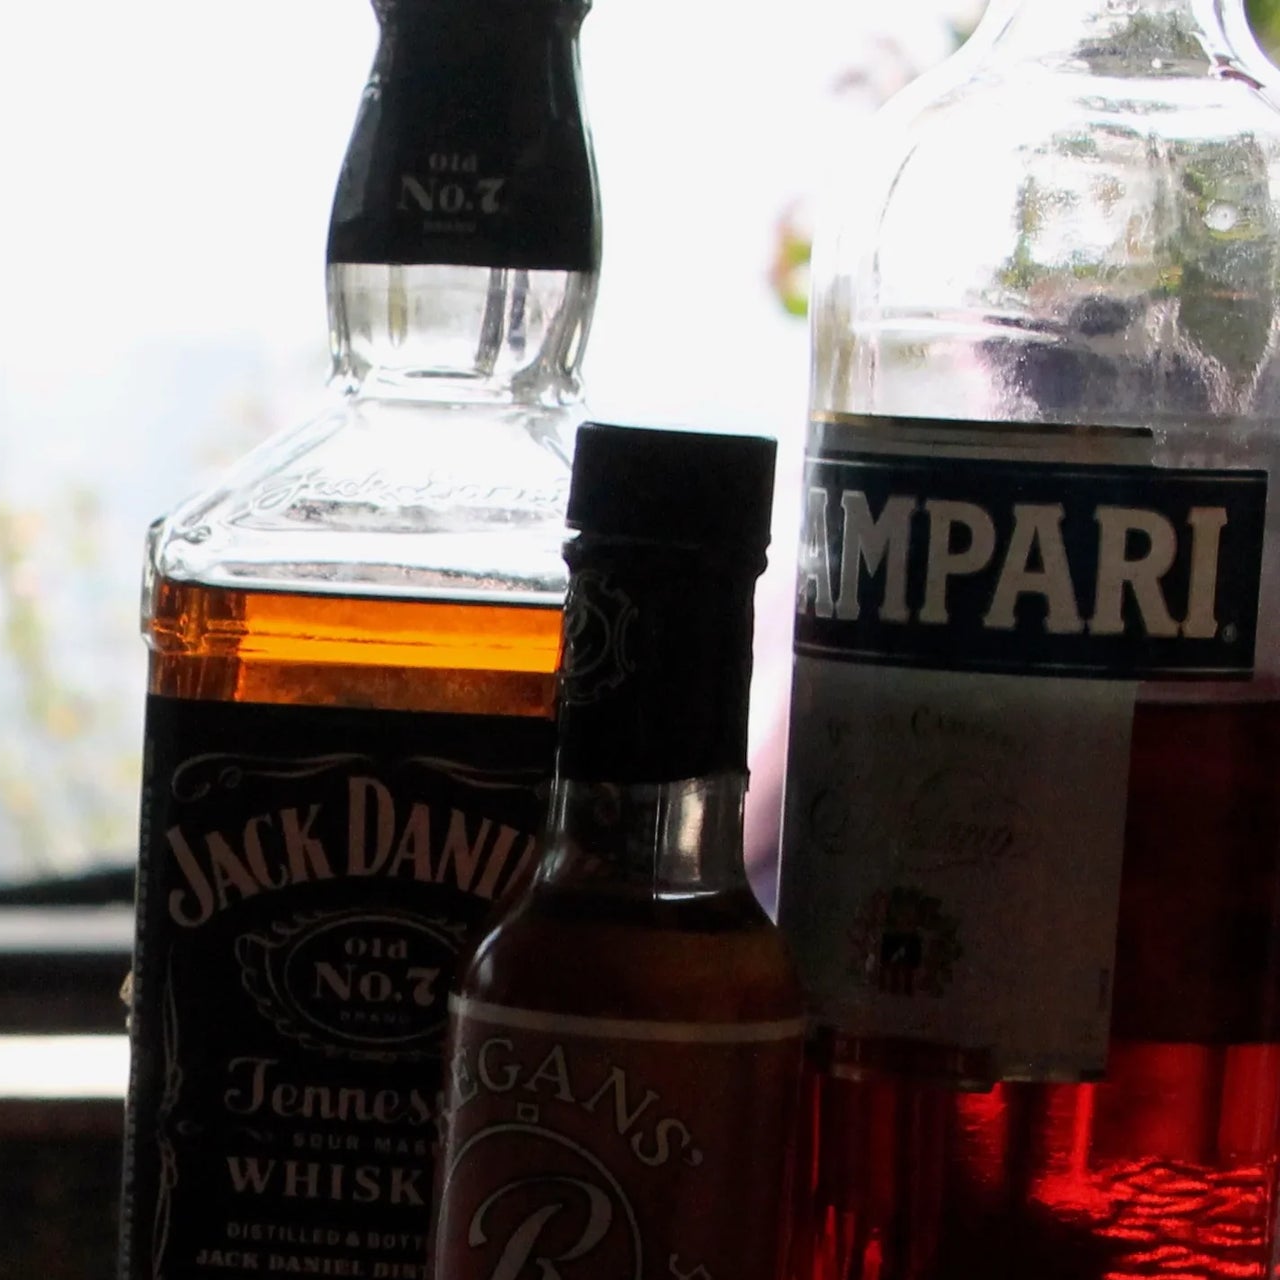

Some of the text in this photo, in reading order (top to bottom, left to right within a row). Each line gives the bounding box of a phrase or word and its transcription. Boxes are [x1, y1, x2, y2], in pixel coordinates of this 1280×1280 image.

[429, 153, 477, 172] Old
[165, 803, 337, 929] JACK
[344, 936, 408, 960] Old
[226, 1156, 426, 1206] WHISK
[226, 1221, 340, 1247] DISTILLED
[195, 1248, 260, 1270] JACK
[268, 1254, 364, 1278] DANIEL
